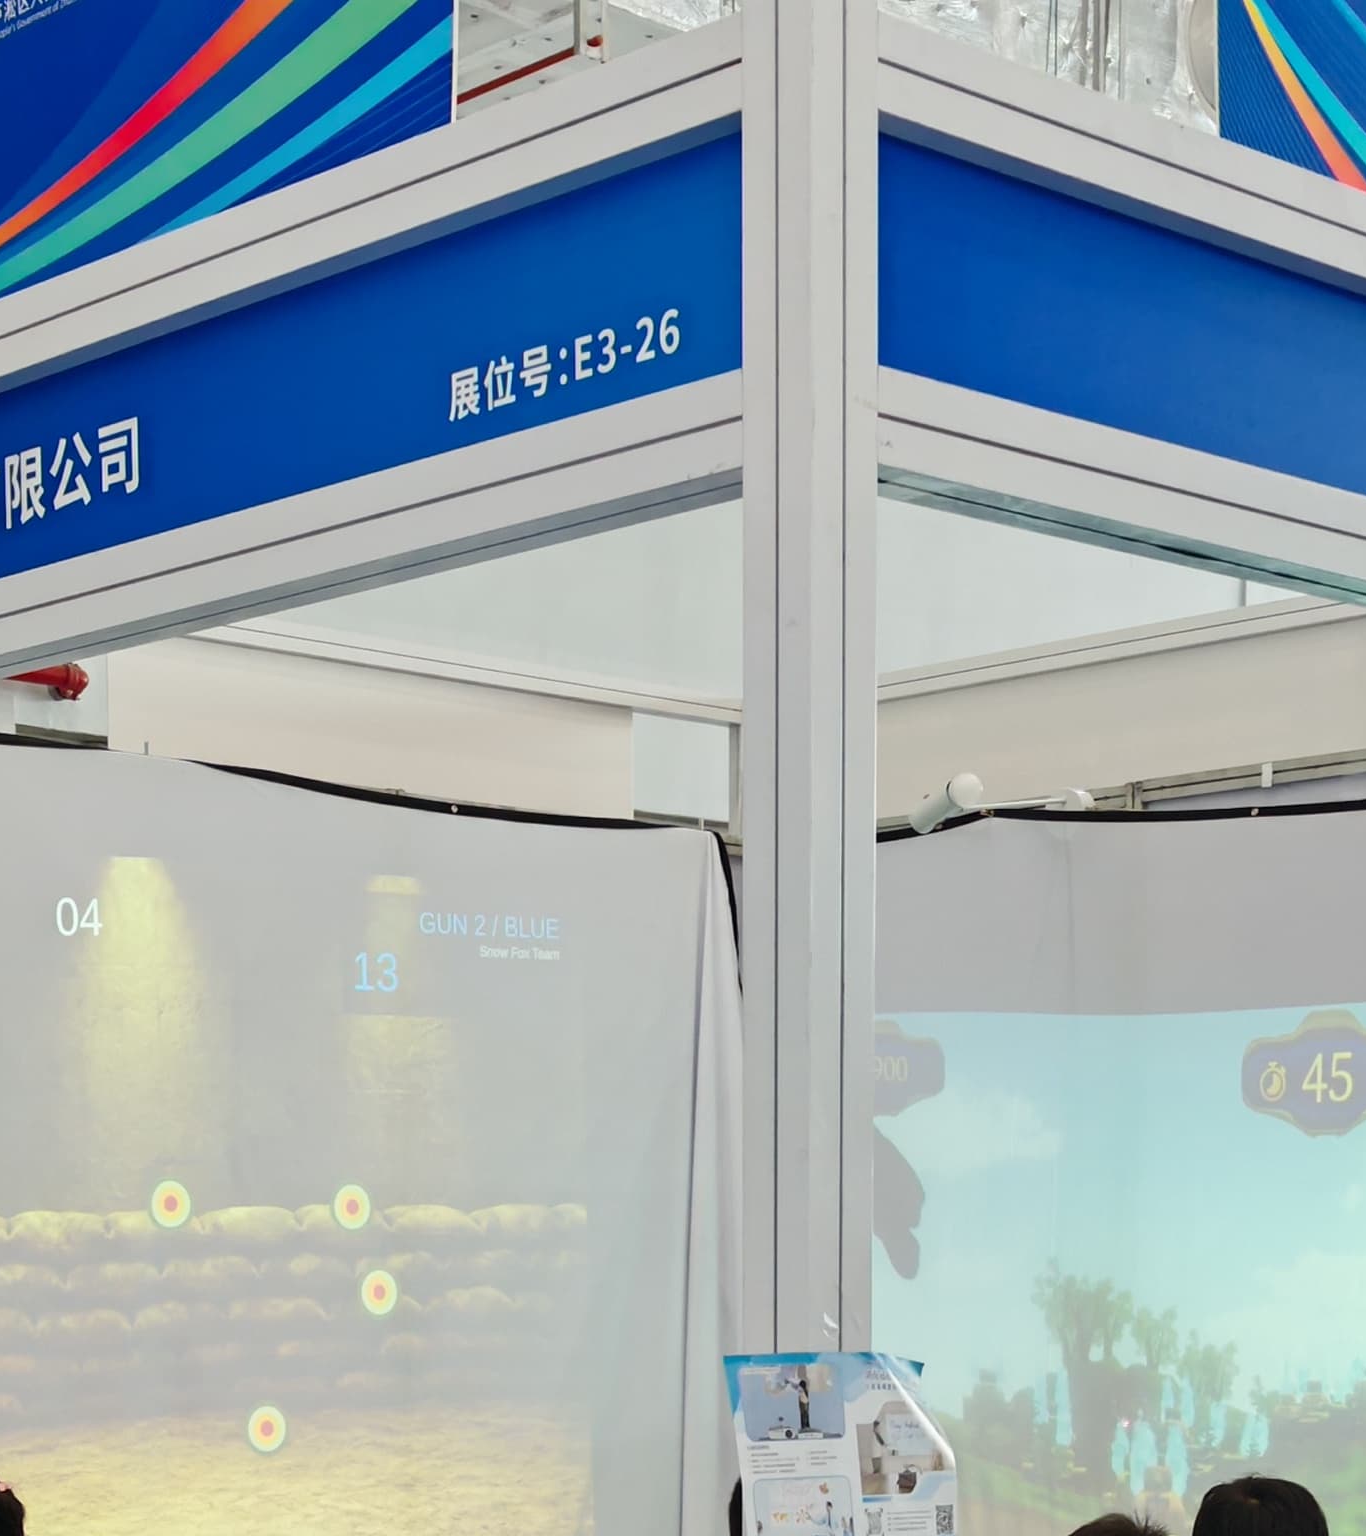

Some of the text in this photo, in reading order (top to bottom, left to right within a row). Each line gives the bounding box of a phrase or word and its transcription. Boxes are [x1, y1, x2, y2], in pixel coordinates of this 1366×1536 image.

[448, 307, 680, 422] 展位号:E3-26
[55, 897, 104, 936] 04
[418, 911, 560, 939] GUN 2 / BLUE
[353, 951, 399, 993] 13
[479, 943, 508, 960] Snow
[531, 946, 560, 962] Team
[1301, 1051, 1354, 1104] 45
